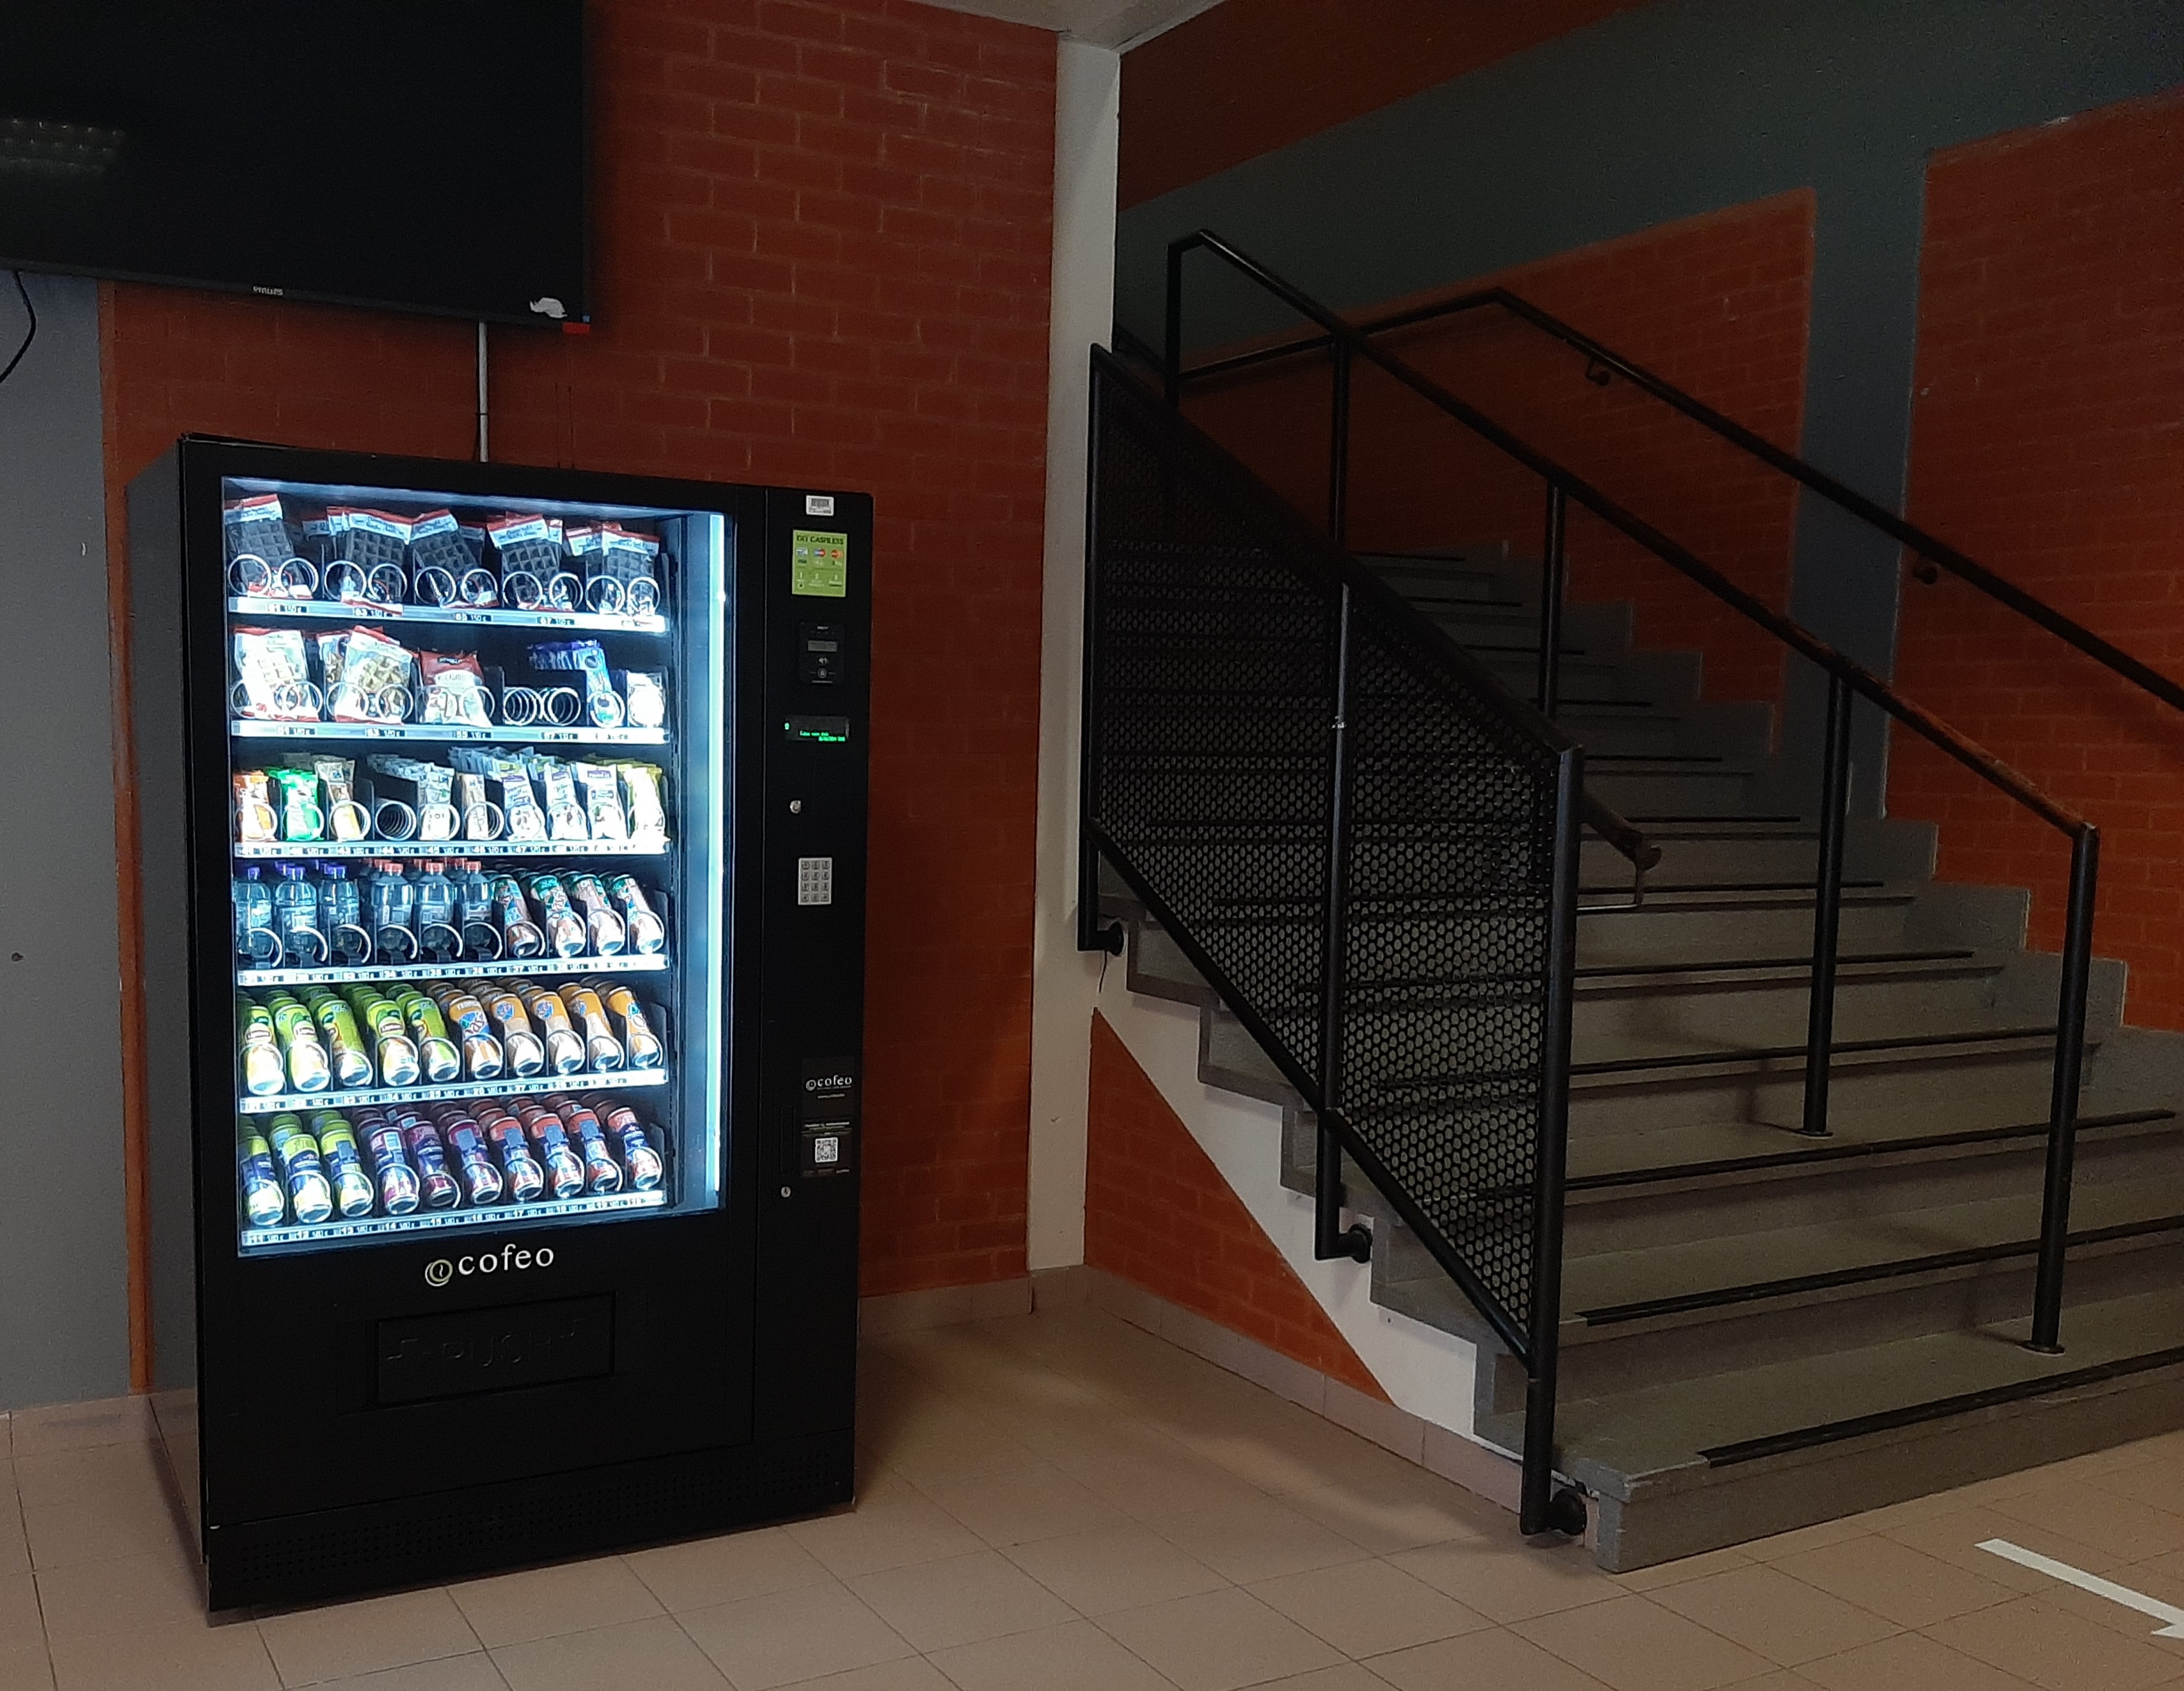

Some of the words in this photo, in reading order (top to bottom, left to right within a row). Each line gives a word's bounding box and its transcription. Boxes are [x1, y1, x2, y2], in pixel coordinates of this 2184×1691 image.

[810, 536, 844, 545] CASHLESS
[817, 1074, 852, 1086] cofeo
[458, 1243, 554, 1276] cofeo
